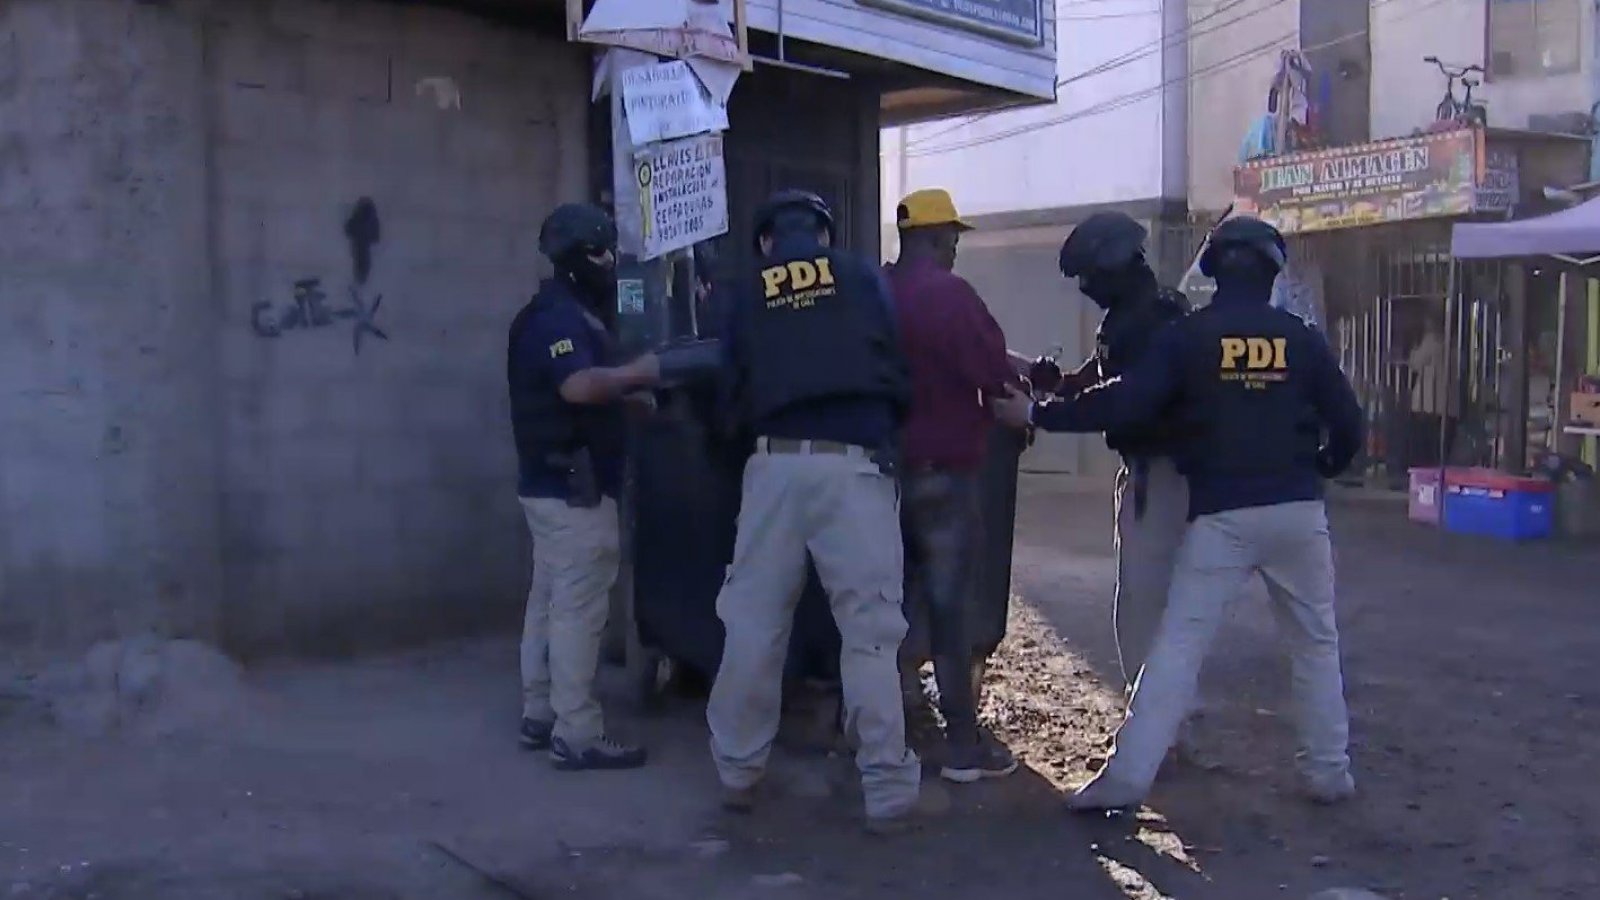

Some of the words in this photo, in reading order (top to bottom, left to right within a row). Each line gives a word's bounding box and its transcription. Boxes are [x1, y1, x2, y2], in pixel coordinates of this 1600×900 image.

[653, 148, 692, 172] LLAVES
[652, 162, 712, 188] REPARACION
[761, 256, 835, 299] PDI
[549, 338, 574, 359] PDI
[1220, 337, 1288, 369] PDI
